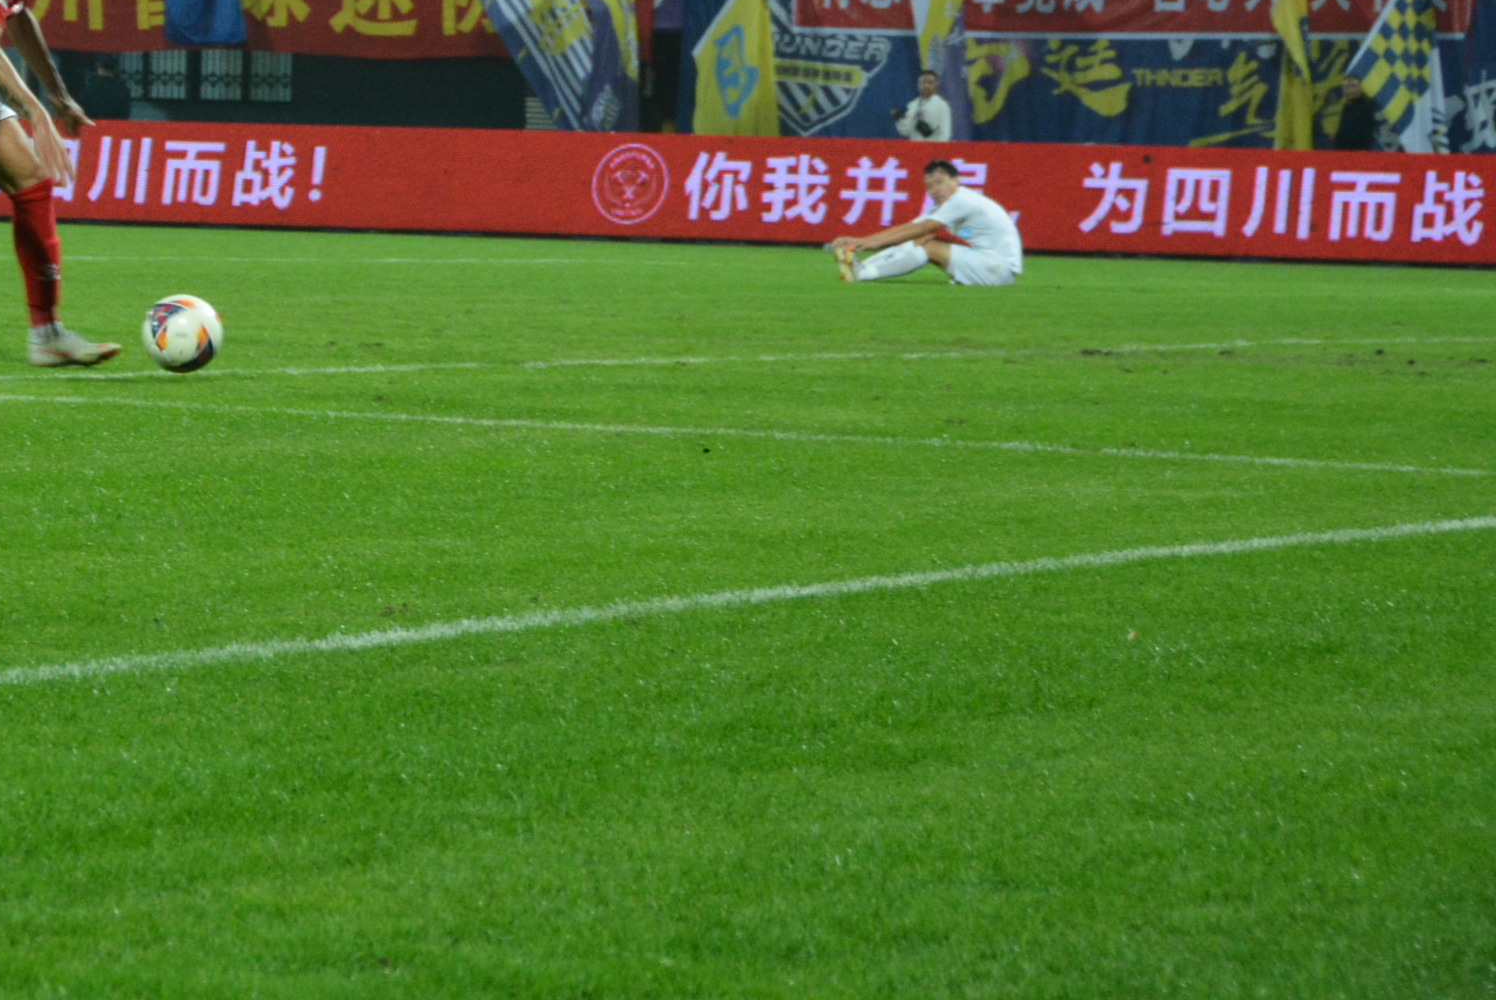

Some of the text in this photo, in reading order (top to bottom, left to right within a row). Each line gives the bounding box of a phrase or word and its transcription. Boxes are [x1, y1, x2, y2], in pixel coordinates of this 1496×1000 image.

[1079, 161, 1485, 246] 为四川而战
